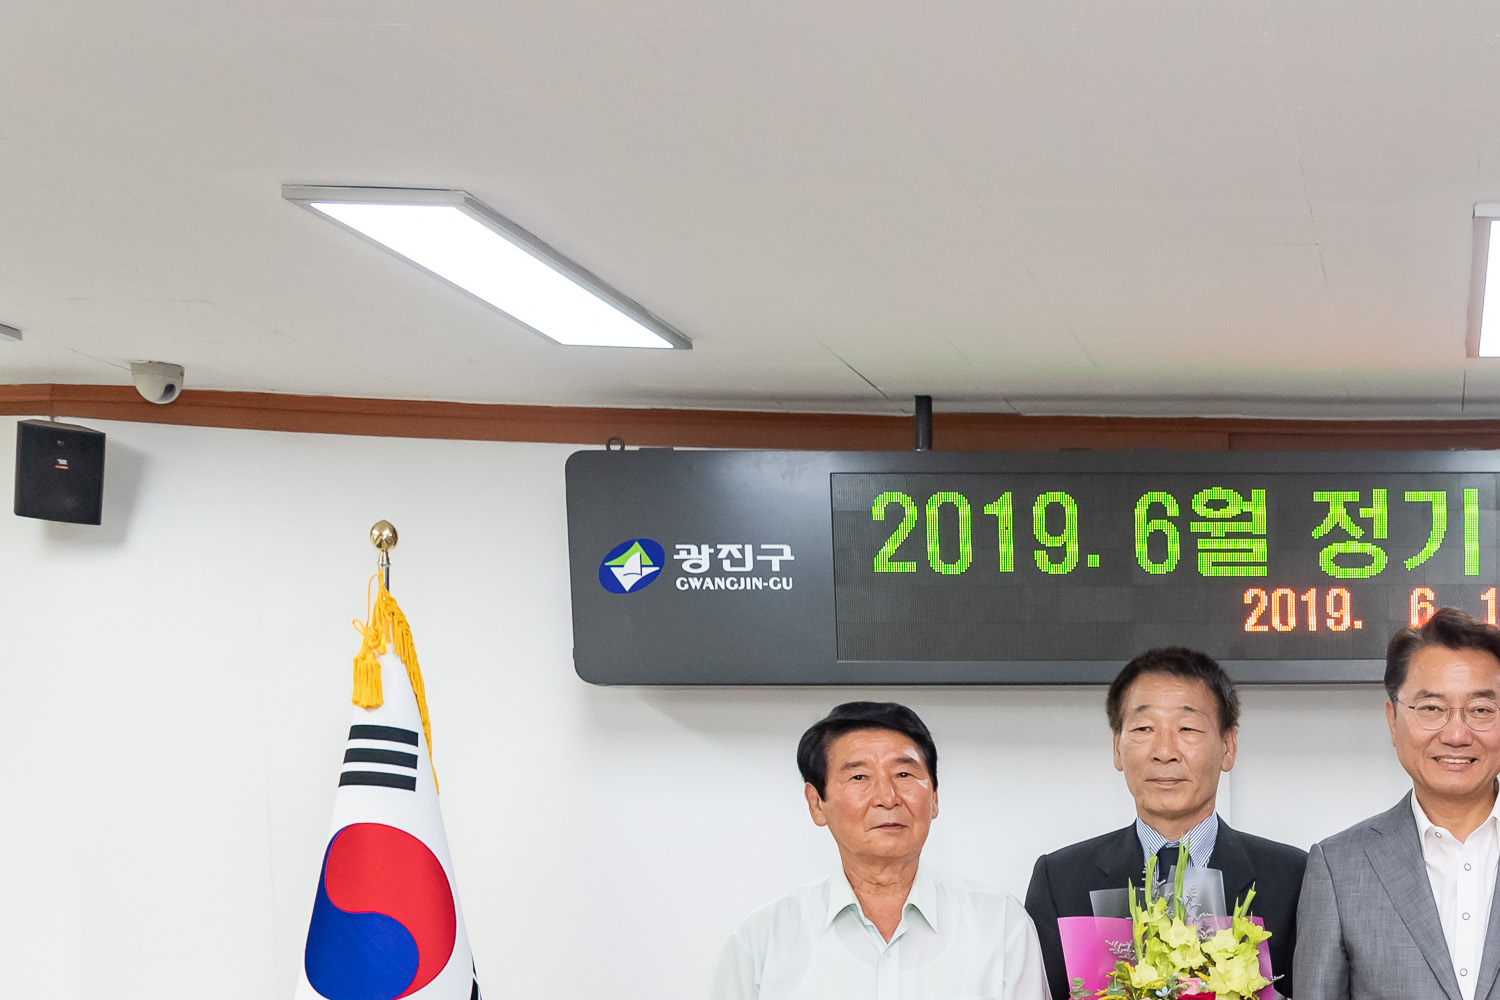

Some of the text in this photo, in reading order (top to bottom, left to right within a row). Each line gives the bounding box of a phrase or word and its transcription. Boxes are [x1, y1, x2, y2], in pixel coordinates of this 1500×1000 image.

[872, 491, 1100, 575] 2019.
[1134, 486, 1268, 577] 6월
[1311, 488, 1480, 578] 정기
[673, 544, 795, 574] 광진구
[675, 577, 793, 591] GWANGJIN-GU
[1243, 588, 1363, 633] 2019.
[1409, 586, 1437, 629] 6
